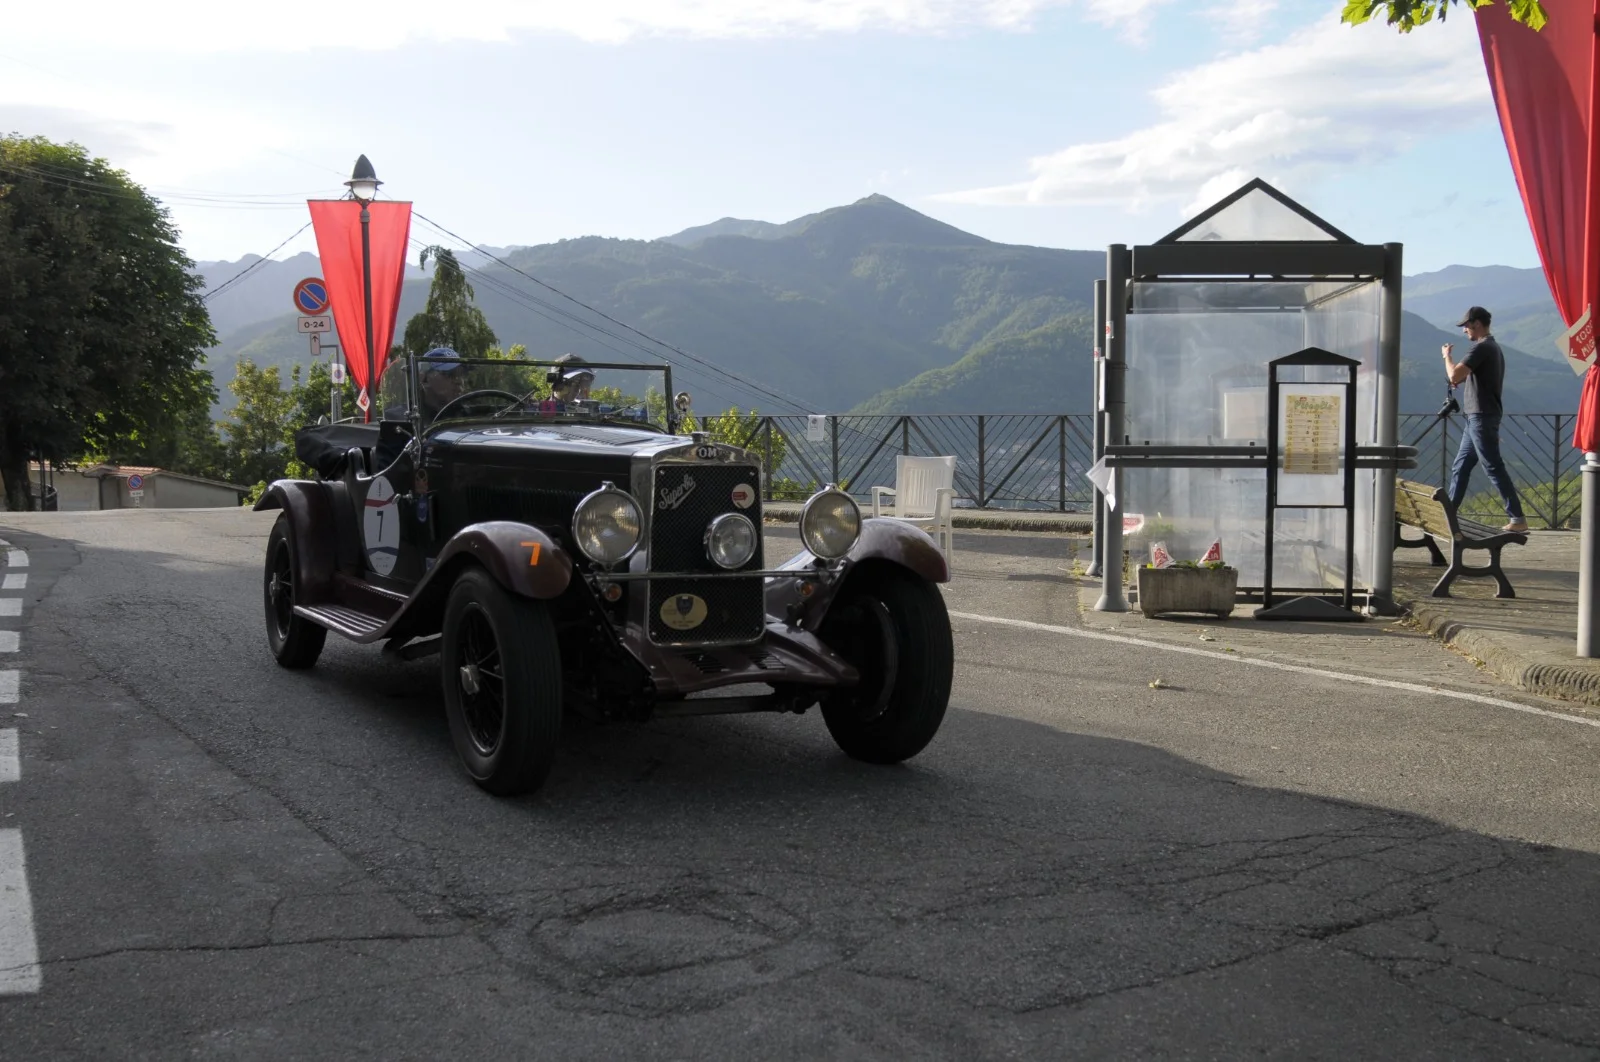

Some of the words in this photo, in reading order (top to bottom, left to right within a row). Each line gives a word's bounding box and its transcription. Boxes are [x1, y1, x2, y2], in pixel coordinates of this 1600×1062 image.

[303, 320, 325, 329] 0-24
[698, 447, 717, 459] OM
[658, 474, 697, 510] Superba
[376, 510, 384, 542] 7
[520, 541, 541, 566] 7
